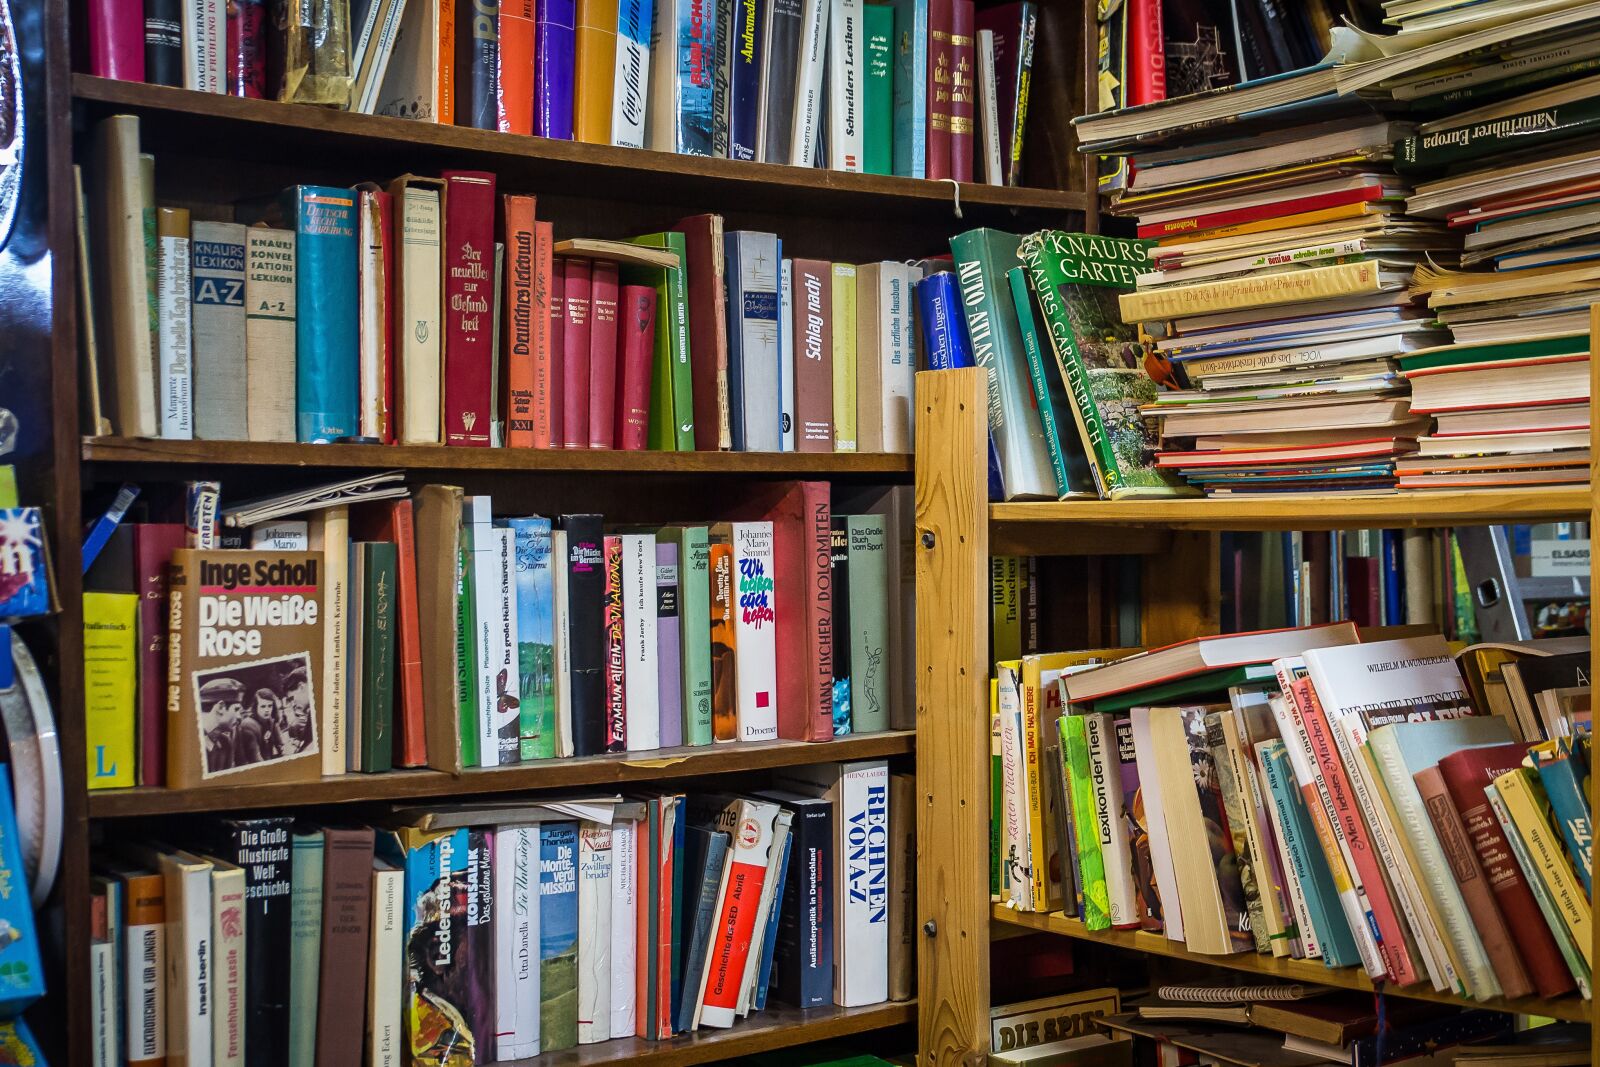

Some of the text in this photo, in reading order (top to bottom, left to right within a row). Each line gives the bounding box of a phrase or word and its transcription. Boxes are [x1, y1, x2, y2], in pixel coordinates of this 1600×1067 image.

[208, 14, 217, 73] FRÜHLING
[690, 42, 702, 85] BUBI
[845, 16, 855, 137] Schneiders Lexikon
[802, 22, 821, 163] HANS-OTTO MEISSNER Kundschafter
[1424, 110, 1558, 149] Naturführer Europa
[1164, 217, 1198, 231] Pocahontas
[195, 243, 244, 257] KNAURS
[251, 239, 293, 250] KNAURS
[461, 242, 482, 261] Der
[1052, 236, 1145, 262] KNAURS
[195, 255, 244, 269] LEXIKON
[251, 273, 293, 284] LEXIKON
[464, 282, 478, 293] zur
[196, 279, 243, 306] A-Z
[259, 300, 286, 312] A-Z
[451, 294, 488, 317] Gesund
[804, 273, 823, 361] Schlag nach!
[932, 297, 946, 330] Jugend
[958, 260, 994, 368] AUTO-ATLAS
[461, 315, 479, 332] heit
[891, 278, 900, 364] Das ärztliche Hausbuch
[1026, 331, 1036, 356] Inseln
[1301, 350, 1322, 361] VOGL
[1052, 321, 1103, 446] GARTENBUCH
[513, 420, 531, 430] XXI
[739, 529, 772, 542] Johannes
[746, 539, 769, 549] Mario
[852, 528, 883, 536] Das Große
[852, 536, 868, 544] Buch
[273, 539, 297, 550] Mario
[742, 548, 770, 557] Simmel
[867, 543, 883, 552] Sport
[200, 559, 317, 590] Inge Scholl
[715, 556, 723, 572] Eden
[1006, 558, 1017, 625] Tatsachen
[200, 595, 318, 627] Die Weiße
[816, 502, 832, 715] HANS FISCHER DOLOMITEN
[199, 627, 262, 657] Rose
[502, 622, 510, 647] große
[611, 623, 621, 639] DE
[1367, 656, 1451, 674] WILHELM WUNDERLICH
[1026, 686, 1034, 733] HAUSTIERE
[746, 725, 776, 737] Droemer
[95, 745, 116, 777] L
[1276, 670, 1344, 841] WAS IST WAS BAND 54 DIE EISENBAHN
[1089, 720, 1112, 845] Lexikon der Tiere
[1262, 748, 1306, 879] Friedrich Dürrenmatt Dame
[1330, 773, 1366, 852] Mein liebstes
[241, 828, 287, 845] Die Große
[541, 837, 575, 847] Thorwald
[238, 848, 289, 863] Illustrierte
[557, 846, 573, 859] Die
[591, 853, 606, 863] Der
[849, 809, 867, 904] VON A-Z
[867, 784, 887, 924] RECHNEN
[253, 864, 280, 880] Welt-
[540, 860, 574, 873] Monte-
[553, 869, 576, 883] verdi
[1531, 828, 1582, 925] Endlich eine Freundin
[246, 882, 290, 898] eschichte
[467, 847, 480, 927] KONSALIK
[479, 847, 493, 926] Das goldene Meer
[540, 882, 576, 896] Mission
[1111, 903, 1121, 921] 2
[143, 929, 156, 962] JUNGEN
[714, 873, 745, 996] Geschichte SED Abriß
[518, 921, 529, 981] Utta Danella
[1321, 942, 1331, 966] Arche
[143, 963, 156, 986] FÜR
[226, 949, 237, 983] Lassie
[381, 876, 394, 1053] Eckert Familienfoto
[1000, 1020, 1039, 1050] DIE
